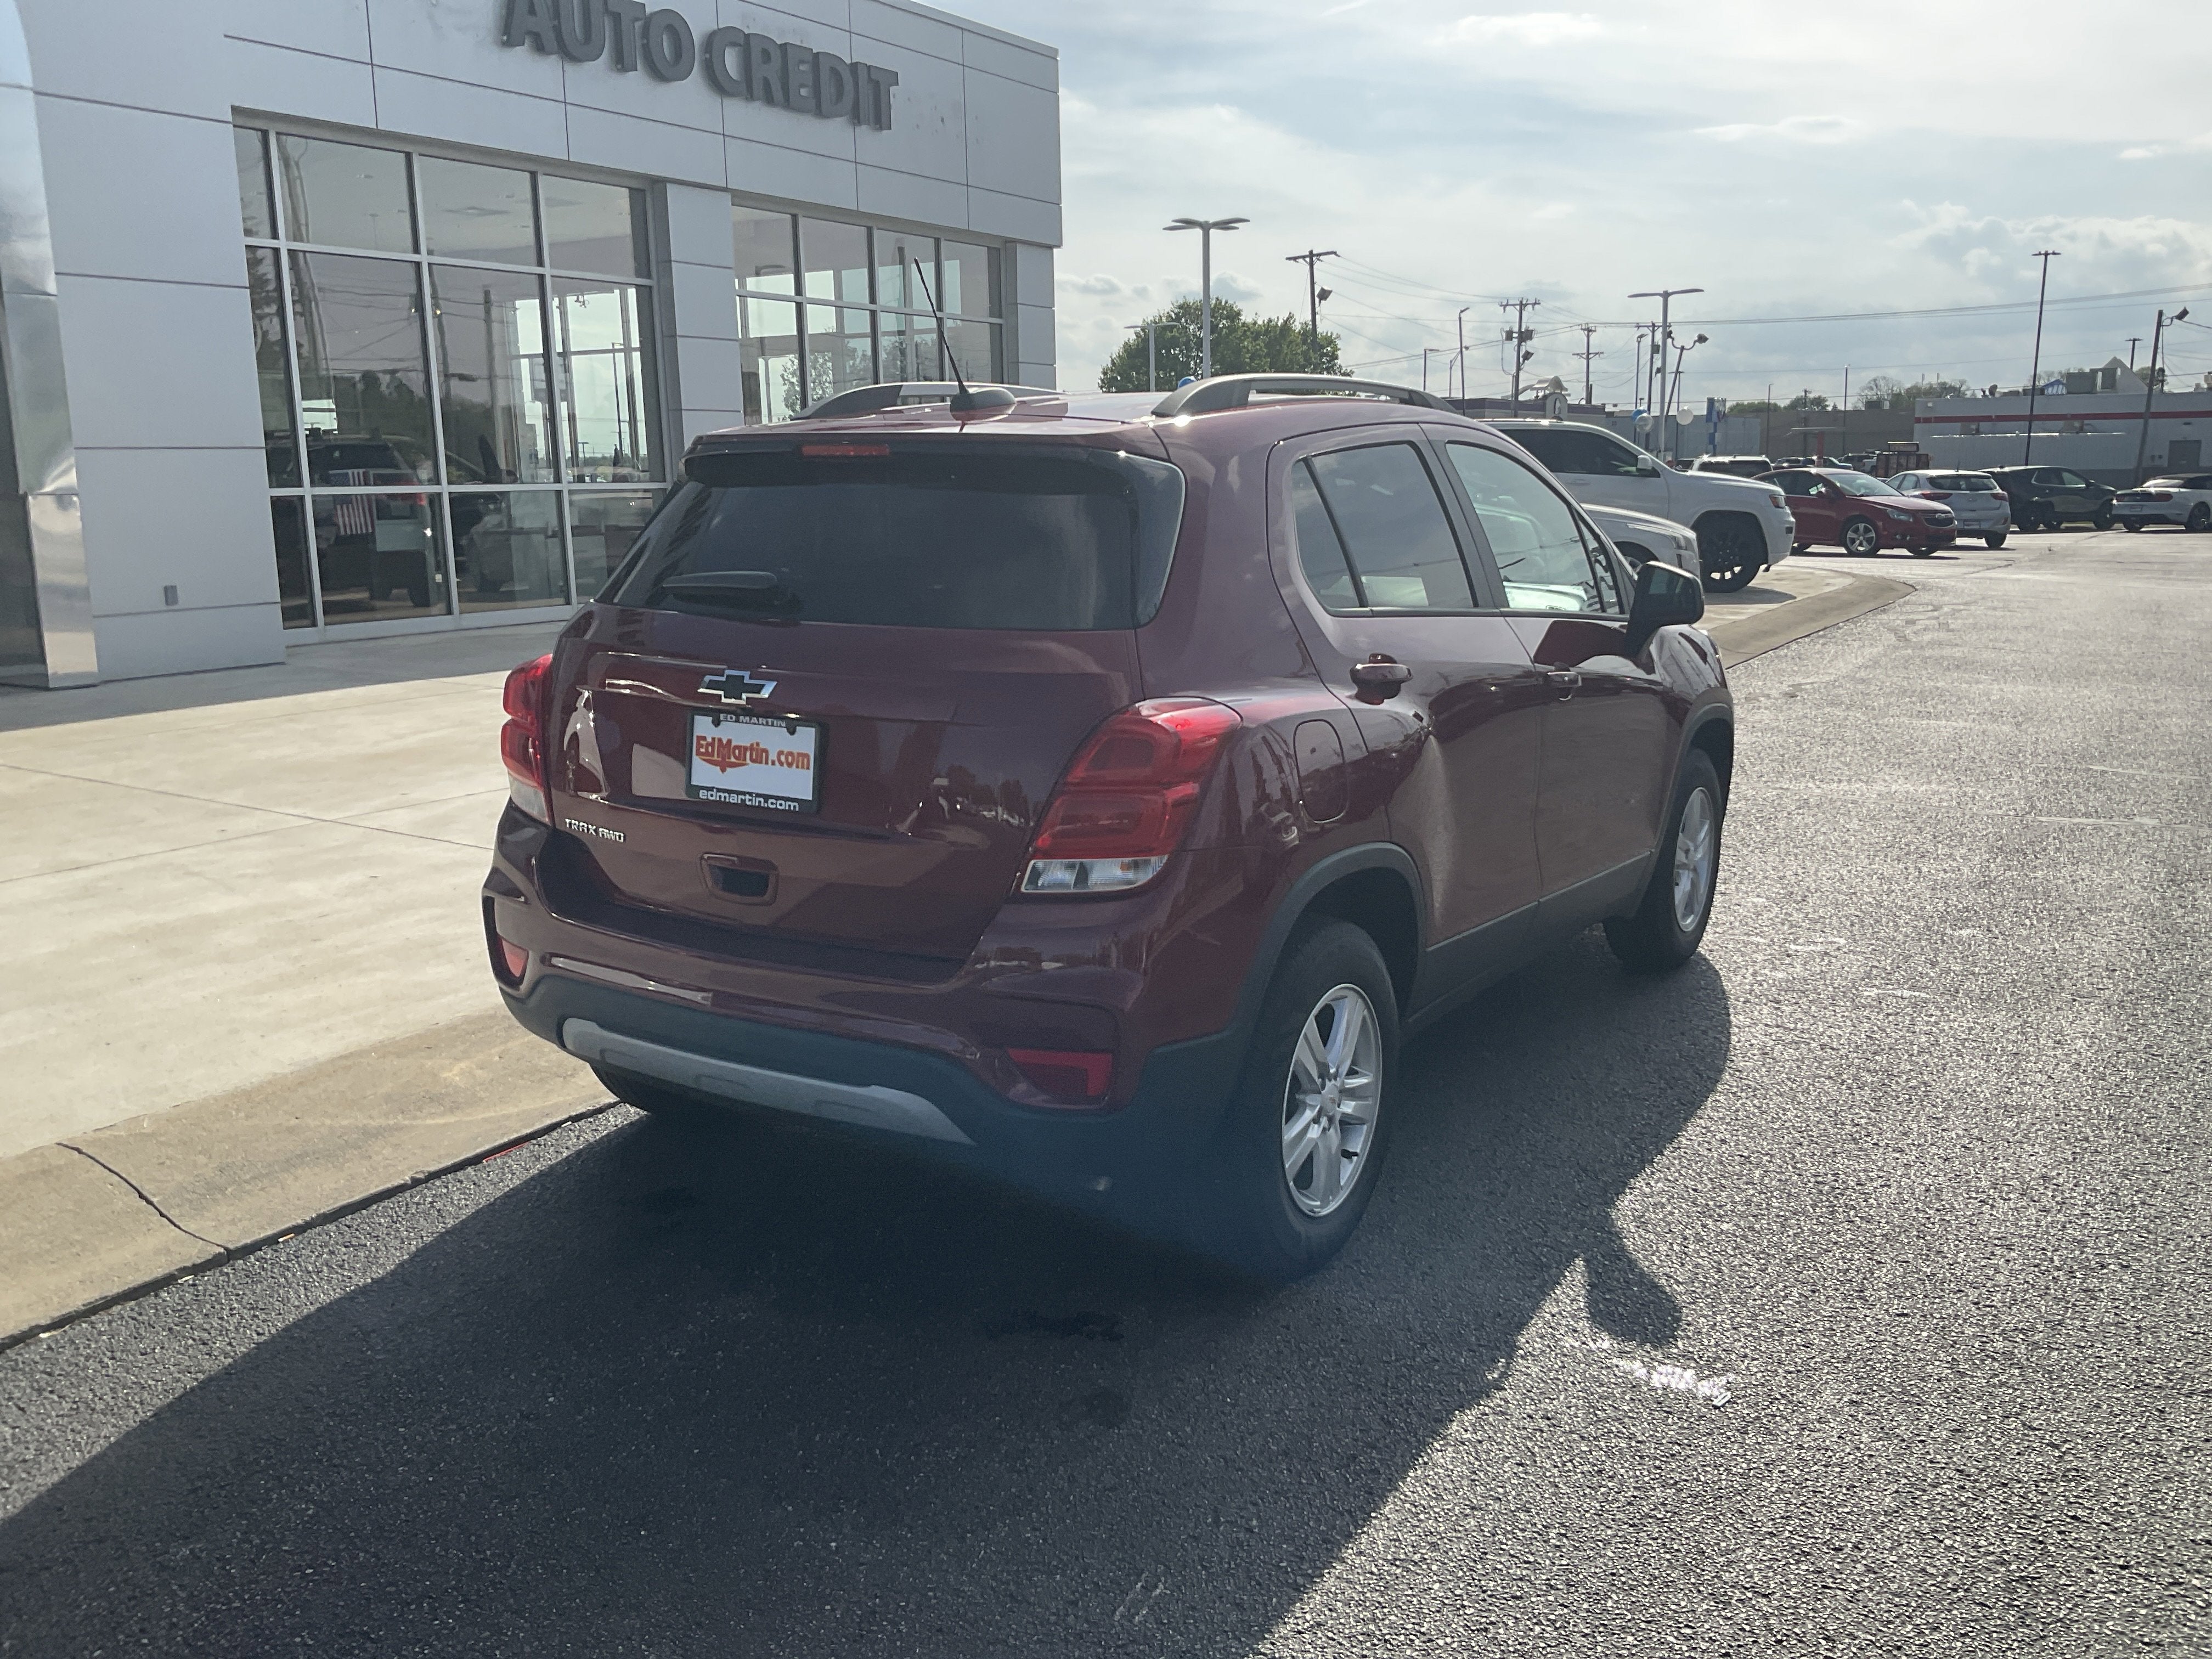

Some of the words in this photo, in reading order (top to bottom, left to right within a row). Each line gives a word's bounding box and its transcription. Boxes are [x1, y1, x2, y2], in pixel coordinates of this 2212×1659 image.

[500, 0, 696, 82] AUTO
[704, 26, 899, 131] CREDIT
[740, 716, 786, 727] MARTIN
[696, 735, 810, 770] EdMartin.com
[699, 789, 799, 811] edmartin.com
[565, 818, 596, 836] TRAX
[599, 827, 624, 842] AWD
